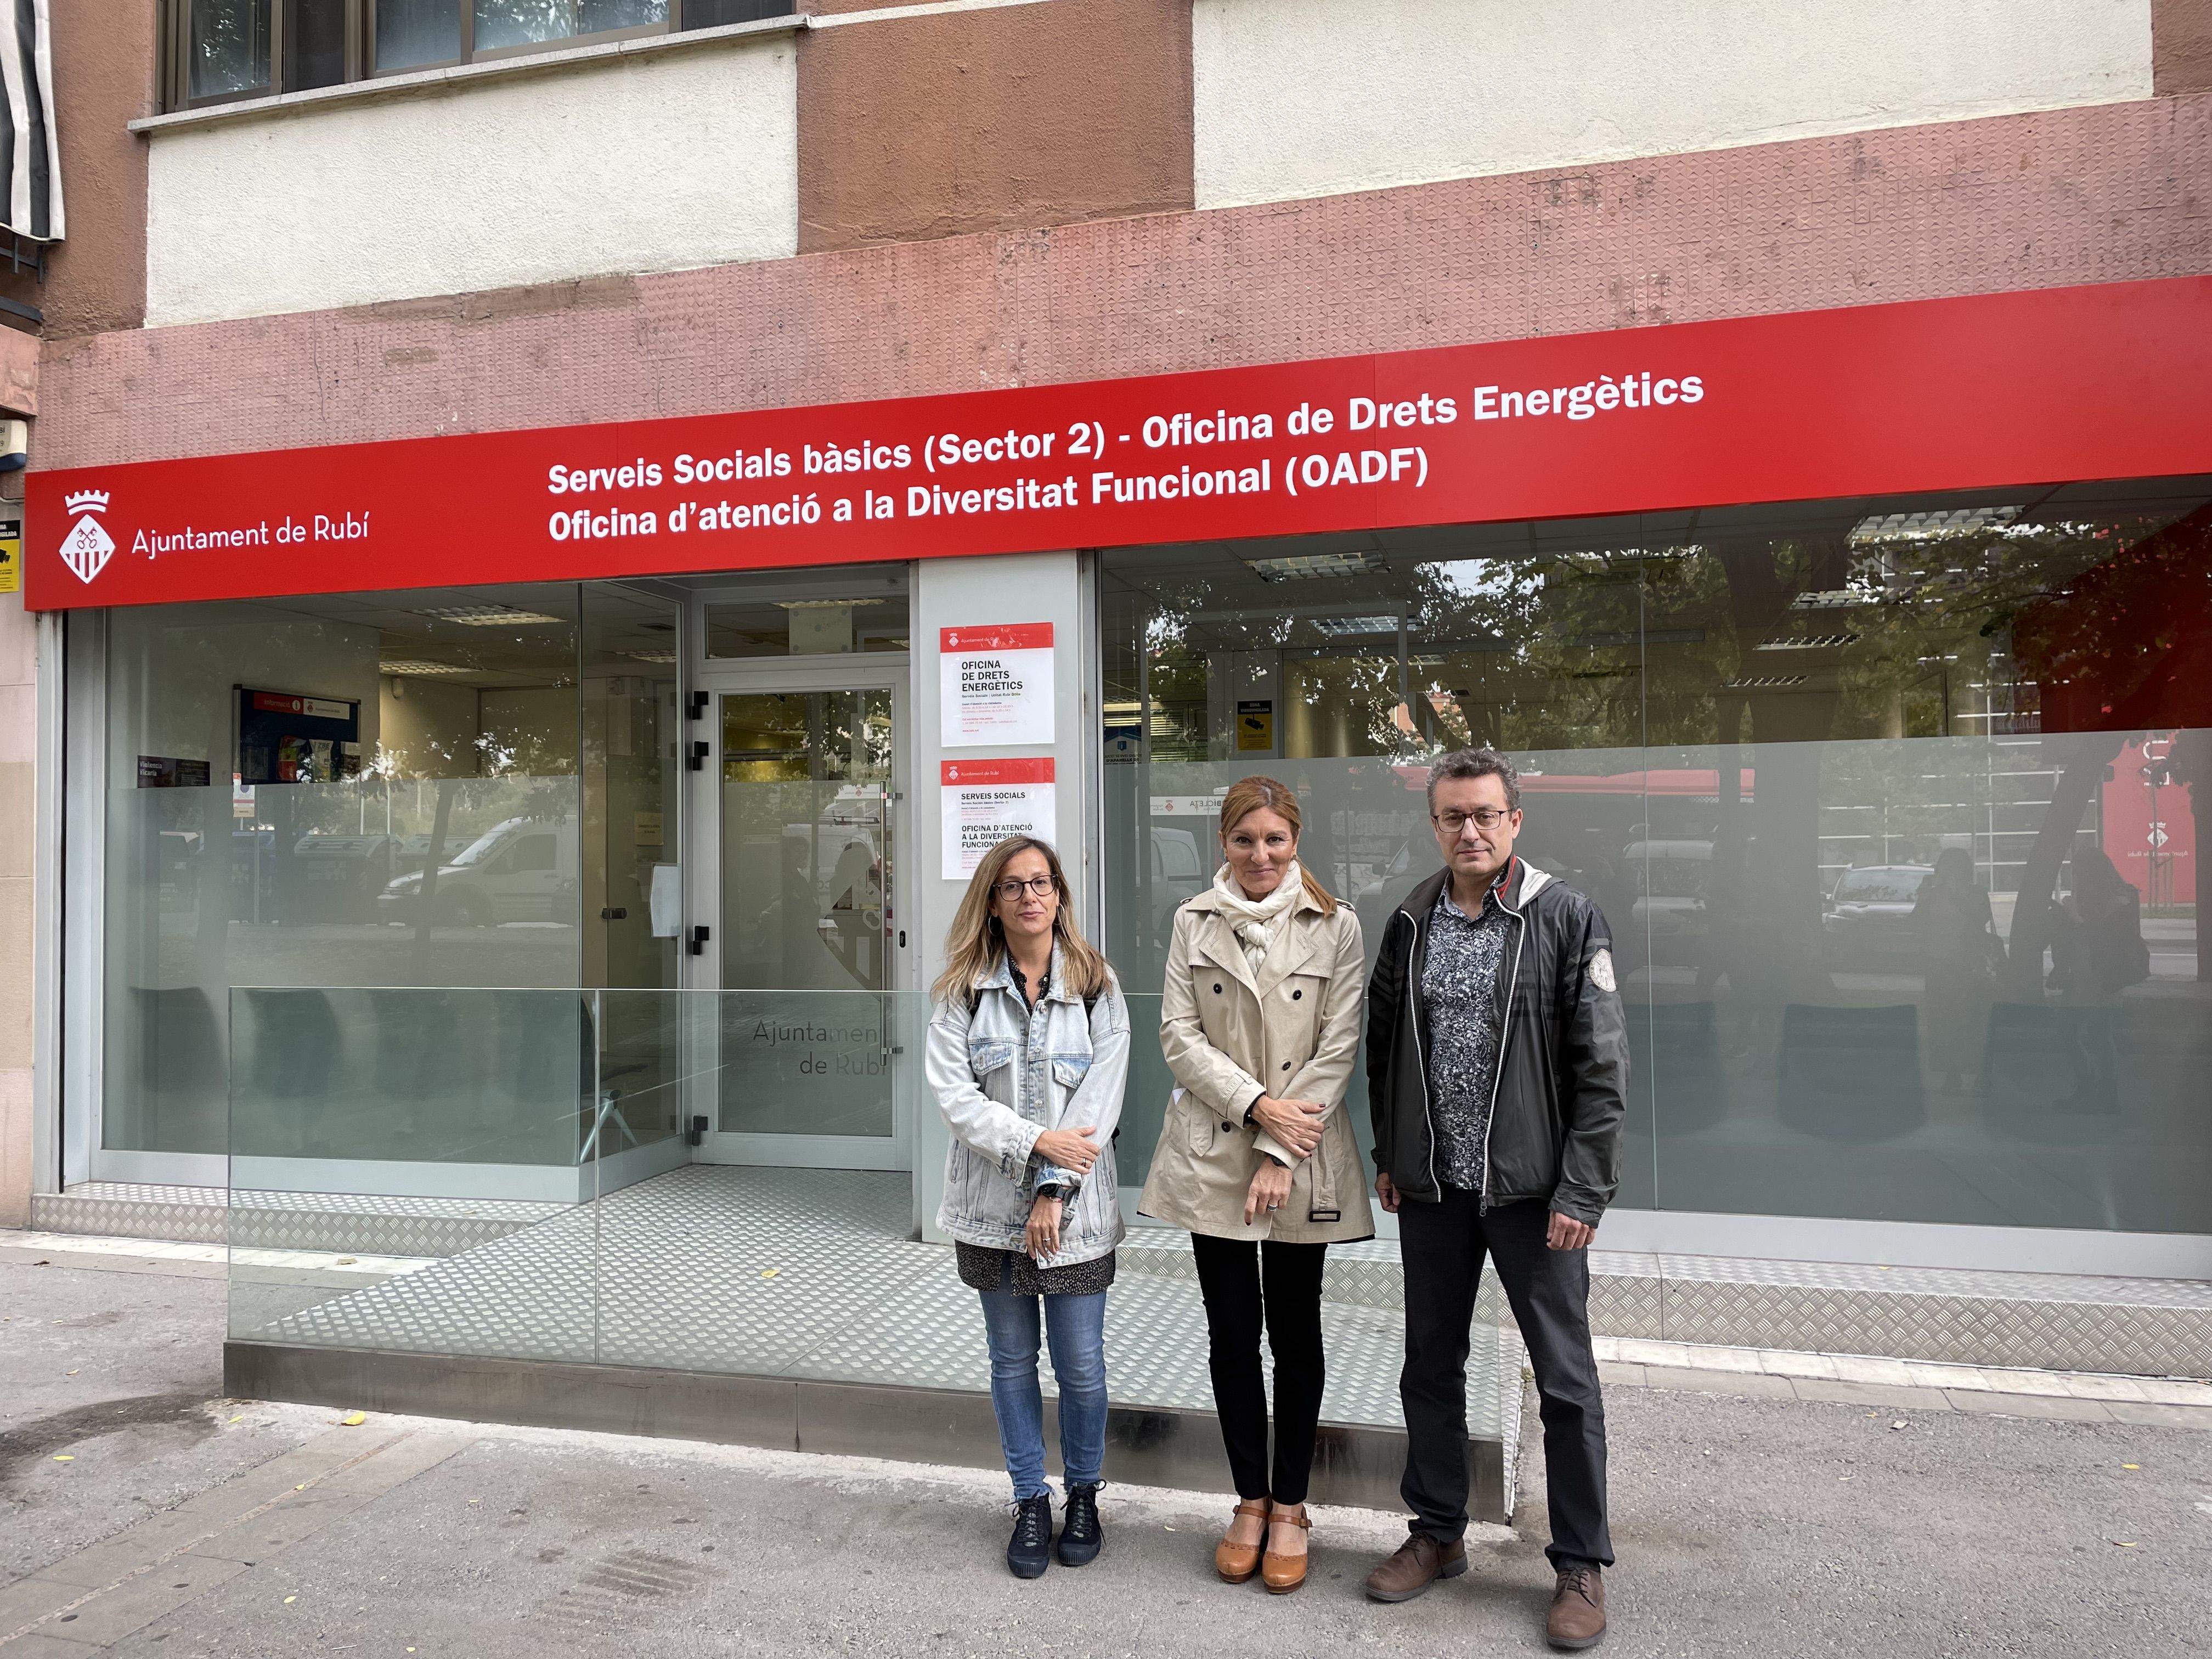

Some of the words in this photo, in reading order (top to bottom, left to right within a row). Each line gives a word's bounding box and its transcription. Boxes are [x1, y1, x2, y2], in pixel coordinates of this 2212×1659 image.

[548, 458, 663, 494] Serveis
[673, 447, 792, 484] Socials
[804, 439, 912, 474] bàsics
[924, 430, 1056, 473] (Sector
[1068, 421, 1105, 460] 2)
[1142, 409, 1273, 448] Oficina
[1287, 402, 1334, 436] de
[1350, 392, 1458, 431] Drets
[1474, 371, 1704, 420] Energètics
[549, 507, 657, 541] Oficina
[668, 492, 821, 533] d’atenció
[833, 498, 852, 522] a
[865, 489, 894, 520] la
[907, 476, 1078, 517] Diversitat
[1092, 459, 1271, 504] Funcional
[1285, 447, 1428, 496] (OADF)
[131, 521, 269, 560] Ajuntament
[276, 516, 306, 544] de
[314, 511, 370, 541] Rubí
[962, 661, 1001, 669] OFICINA
[978, 670, 1009, 680] DRETS
[962, 680, 1023, 691] ENERGÈTICS
[753, 1019, 878, 1047] Ajuntamen
[799, 1051, 827, 1075] de
